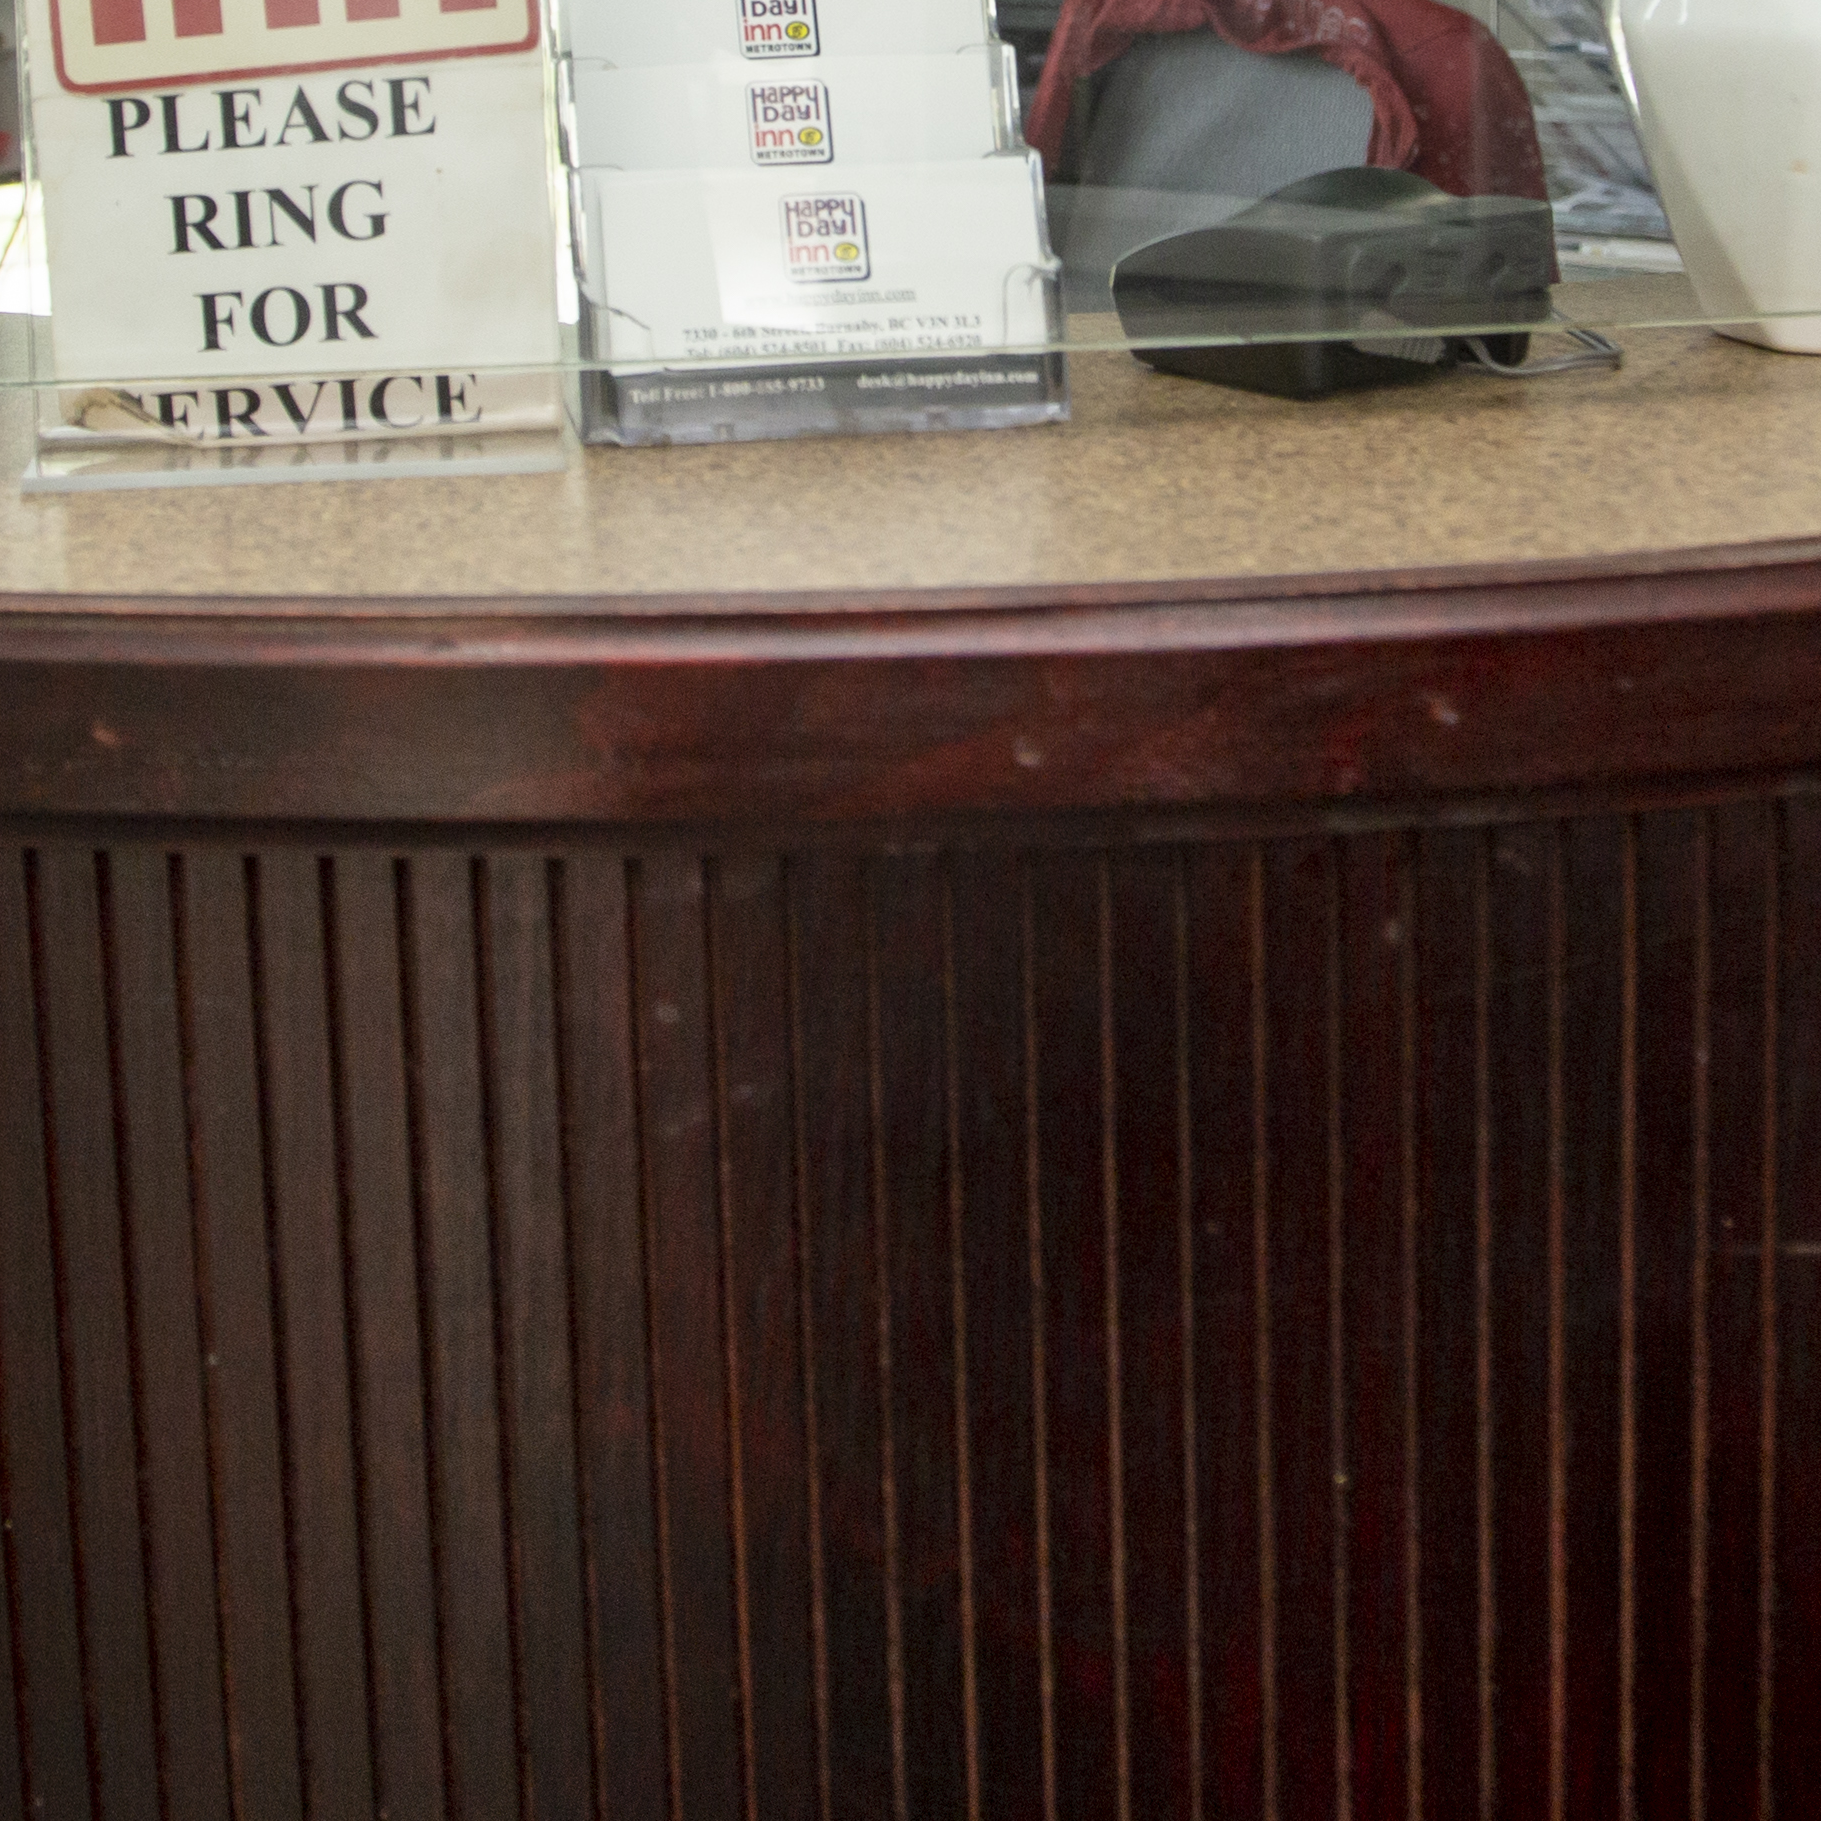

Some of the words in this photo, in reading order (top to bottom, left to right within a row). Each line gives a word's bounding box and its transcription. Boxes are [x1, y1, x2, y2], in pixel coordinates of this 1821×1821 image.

[743, 19, 782, 41] inn
[746, 43, 813, 53] METROTOWN
[103, 75, 438, 160] PLEASE
[754, 124, 795, 147] inn
[757, 148, 826, 160] METROTOWN
[165, 179, 390, 256] RING
[194, 281, 378, 353] FOR
[120, 373, 482, 441] ERVICE
